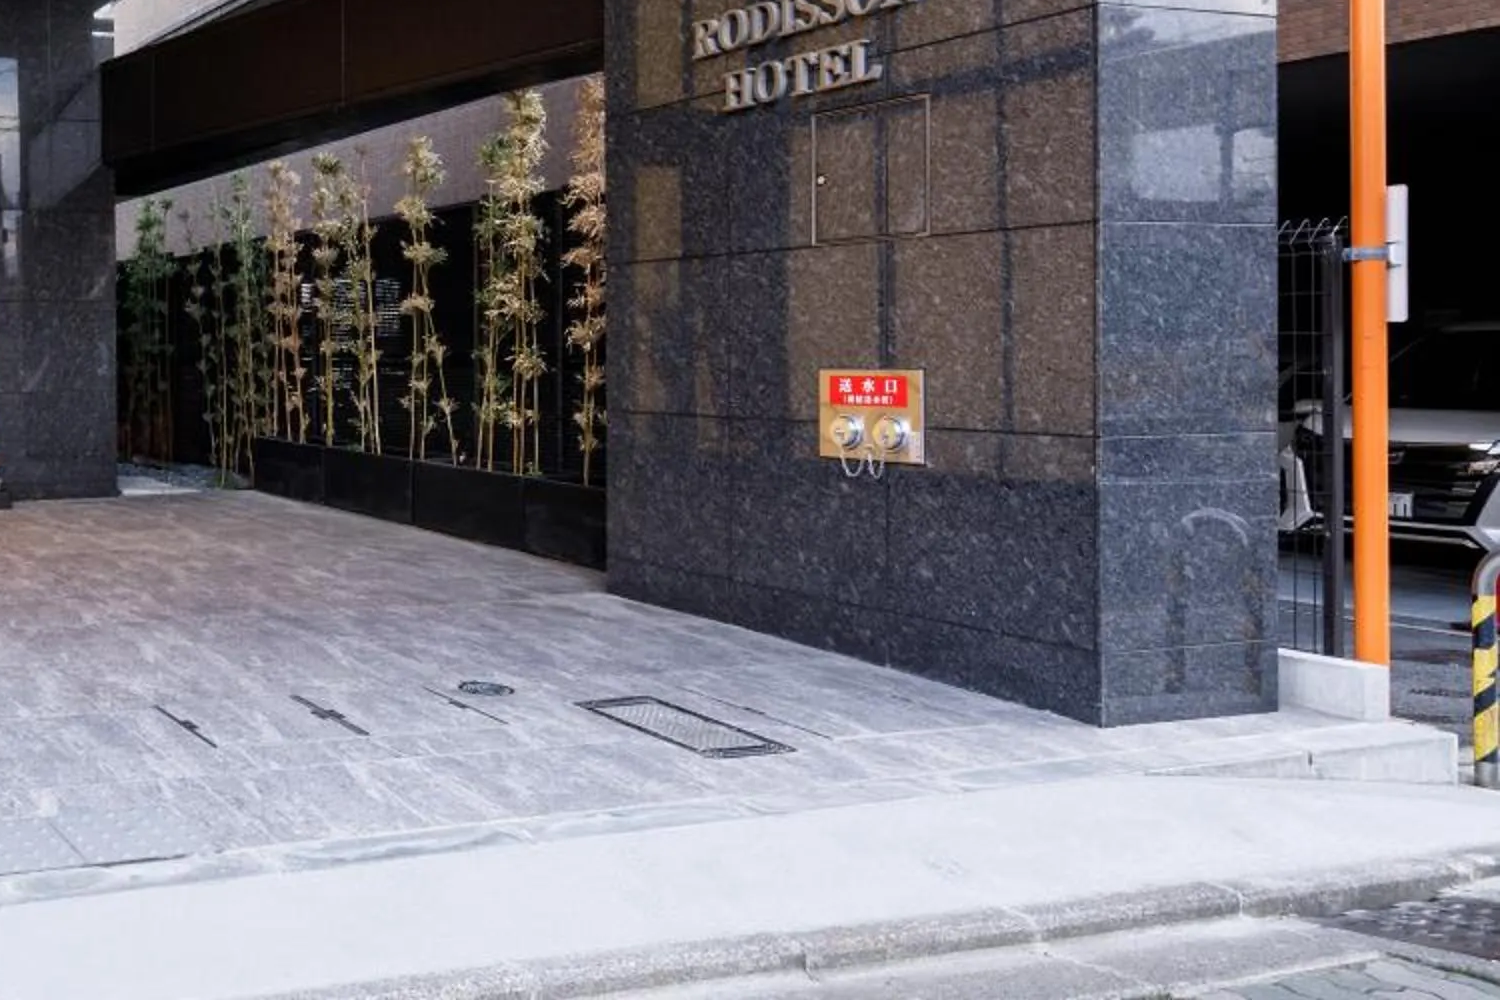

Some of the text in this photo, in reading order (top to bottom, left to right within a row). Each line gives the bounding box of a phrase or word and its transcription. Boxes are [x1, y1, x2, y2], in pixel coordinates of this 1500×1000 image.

[722, 40, 884, 112] HOTEL
[838, 377, 898, 393] 送水口
